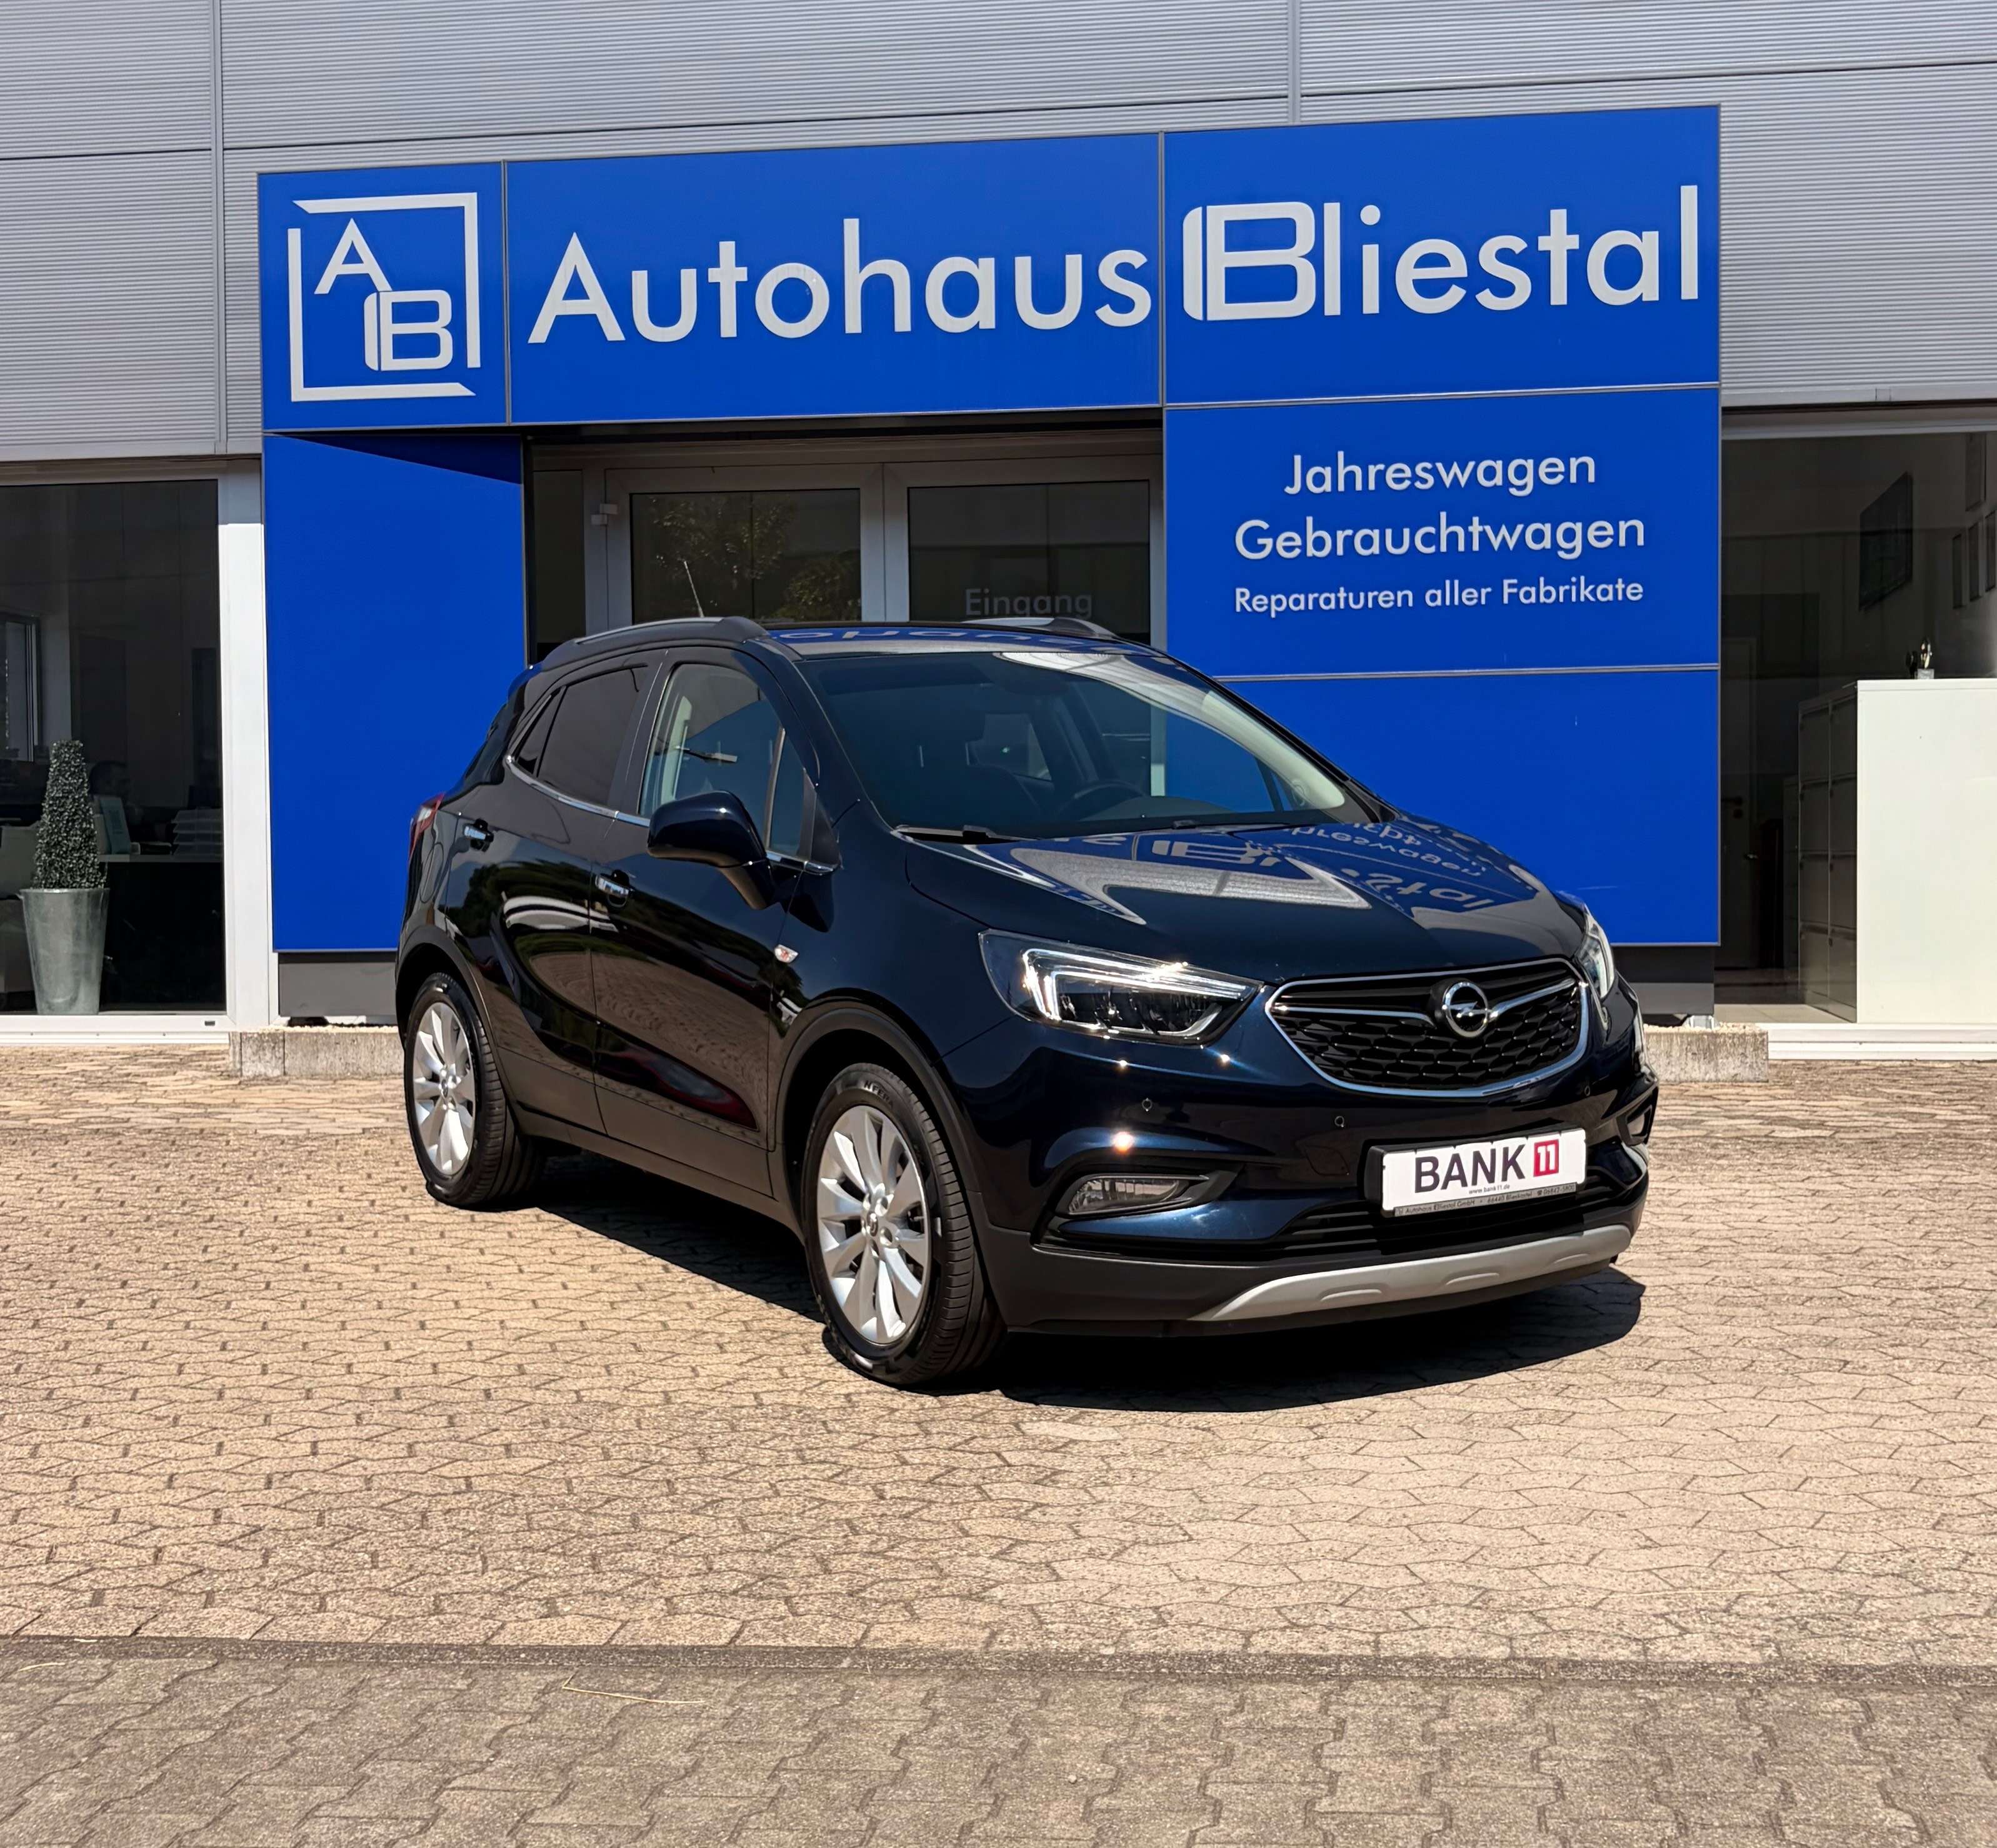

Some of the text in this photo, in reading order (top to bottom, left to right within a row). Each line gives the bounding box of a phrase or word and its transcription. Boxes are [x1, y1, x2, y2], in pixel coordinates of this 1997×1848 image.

[528, 184, 1699, 343] Autohaus Bliestal
[1284, 451, 1596, 497] Jahreswagen
[1234, 511, 1644, 560] Gebrauchtwagen
[966, 588, 1092, 620] Eingang
[1235, 576, 1644, 618] Reparaturen aller Fabrikate
[1414, 1142, 1557, 1193] BANK 11
[1405, 1205, 1432, 1213] Autohaus
